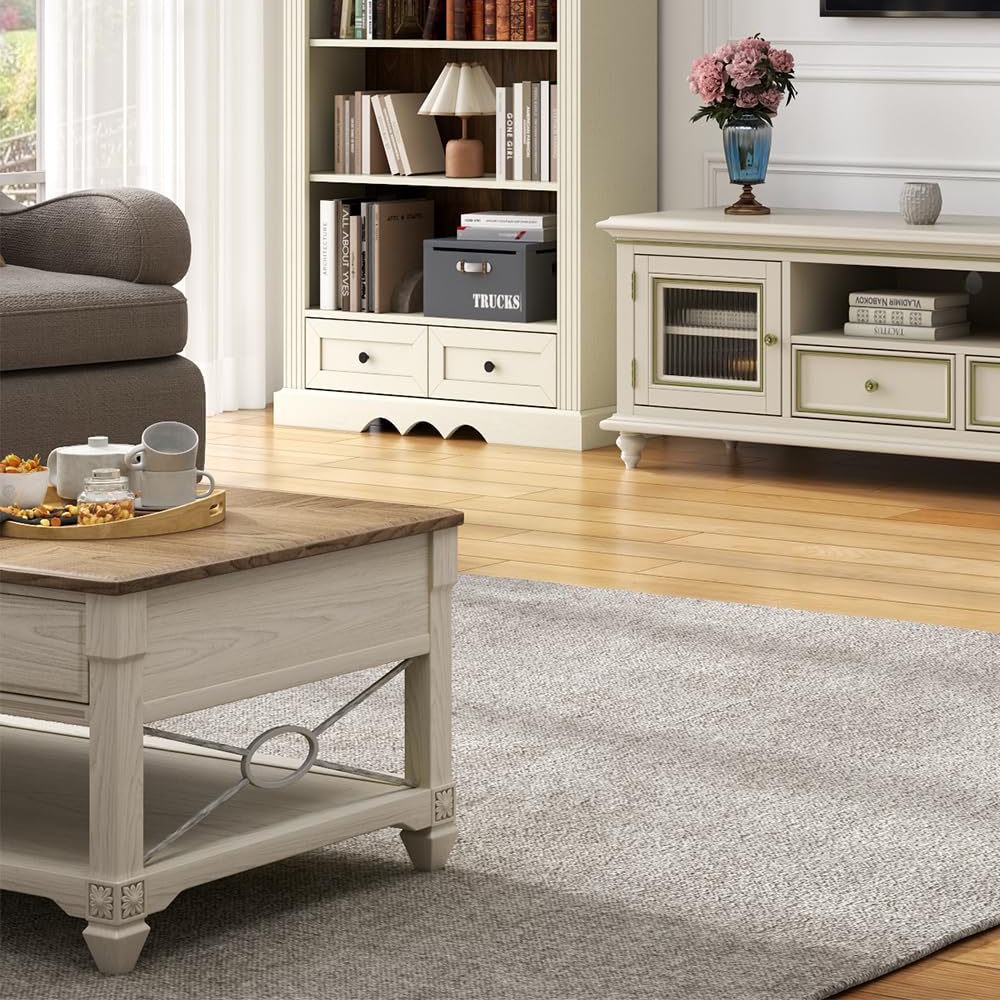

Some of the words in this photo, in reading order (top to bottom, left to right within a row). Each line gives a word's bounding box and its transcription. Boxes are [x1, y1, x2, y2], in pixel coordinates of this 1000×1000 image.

[341, 272, 349, 297] YVES
[473, 292, 520, 310] TRUCKS
[855, 296, 888, 306] NABOKOV
[889, 298, 921, 308] VLADIMIR
[873, 327, 905, 337] TACITUS
